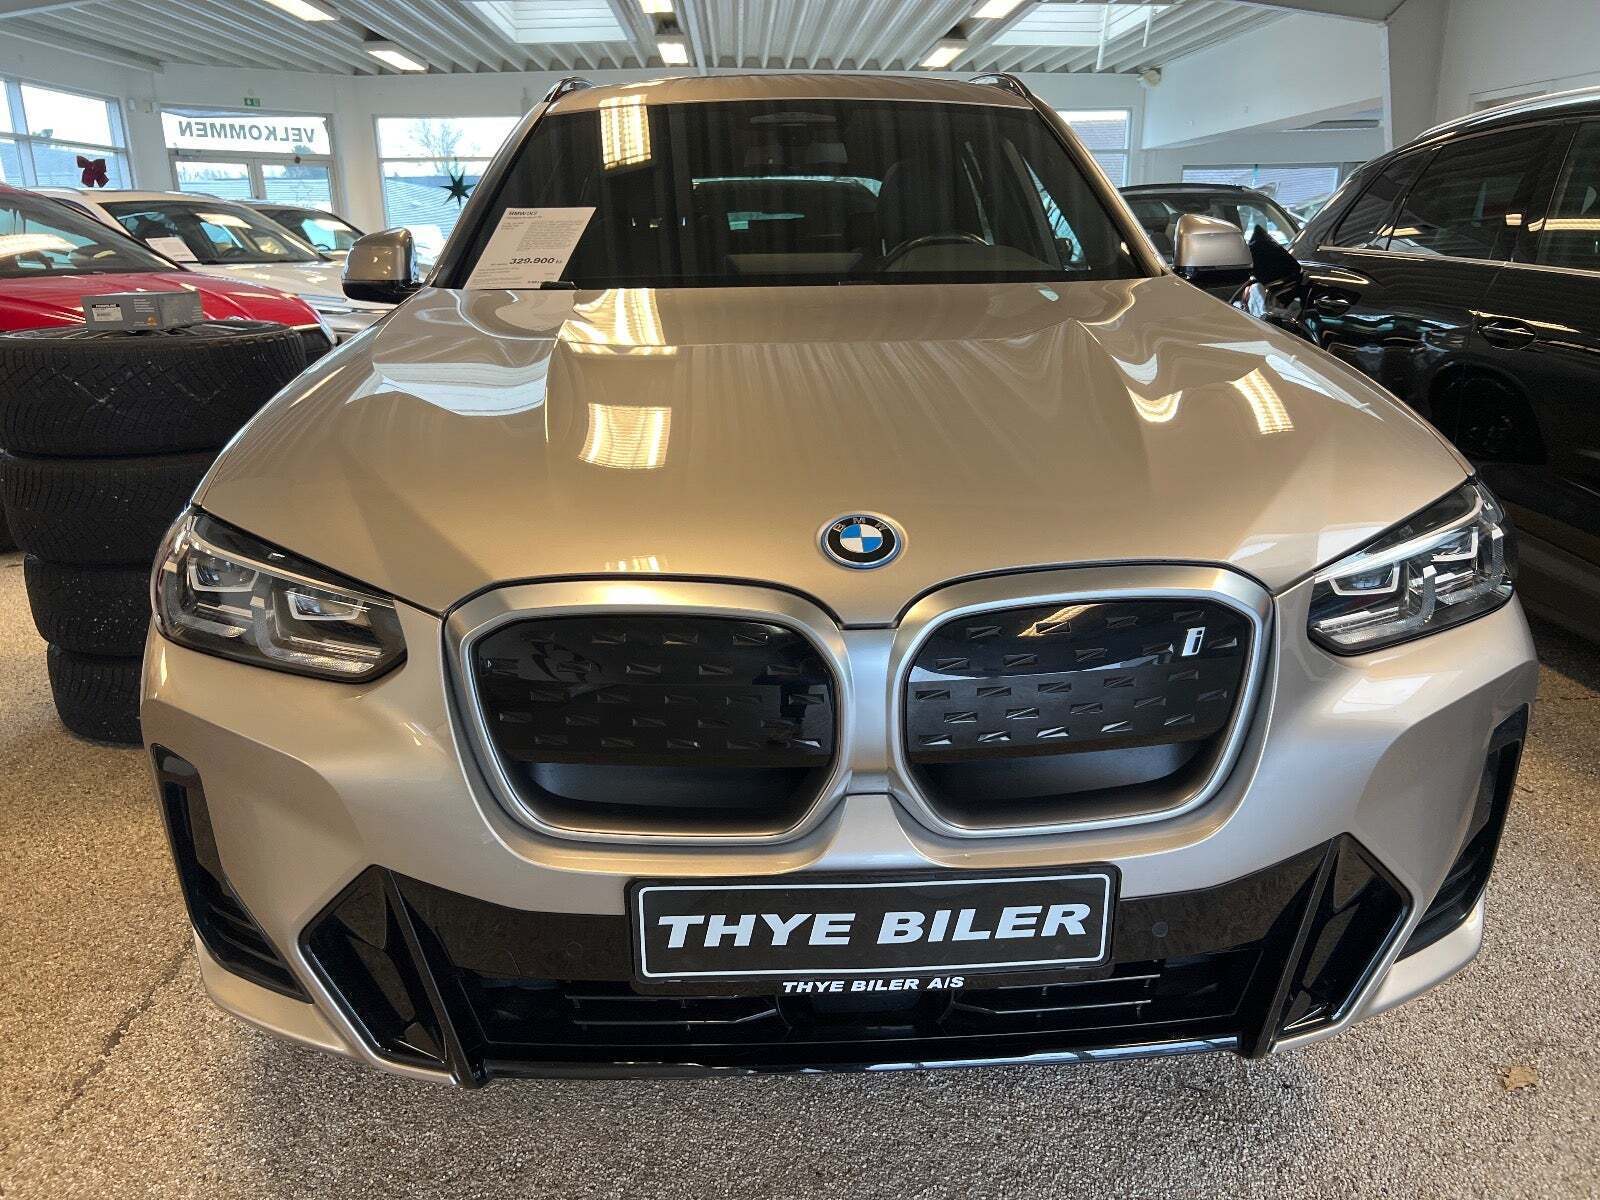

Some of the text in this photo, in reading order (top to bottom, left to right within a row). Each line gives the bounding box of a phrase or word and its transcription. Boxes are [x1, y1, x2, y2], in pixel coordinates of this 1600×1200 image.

[509, 257, 555, 265] 329.900
[832, 517, 887, 533] BMW
[657, 903, 1092, 949] THYE BILER
[782, 976, 965, 993] THYE BILER A/S
